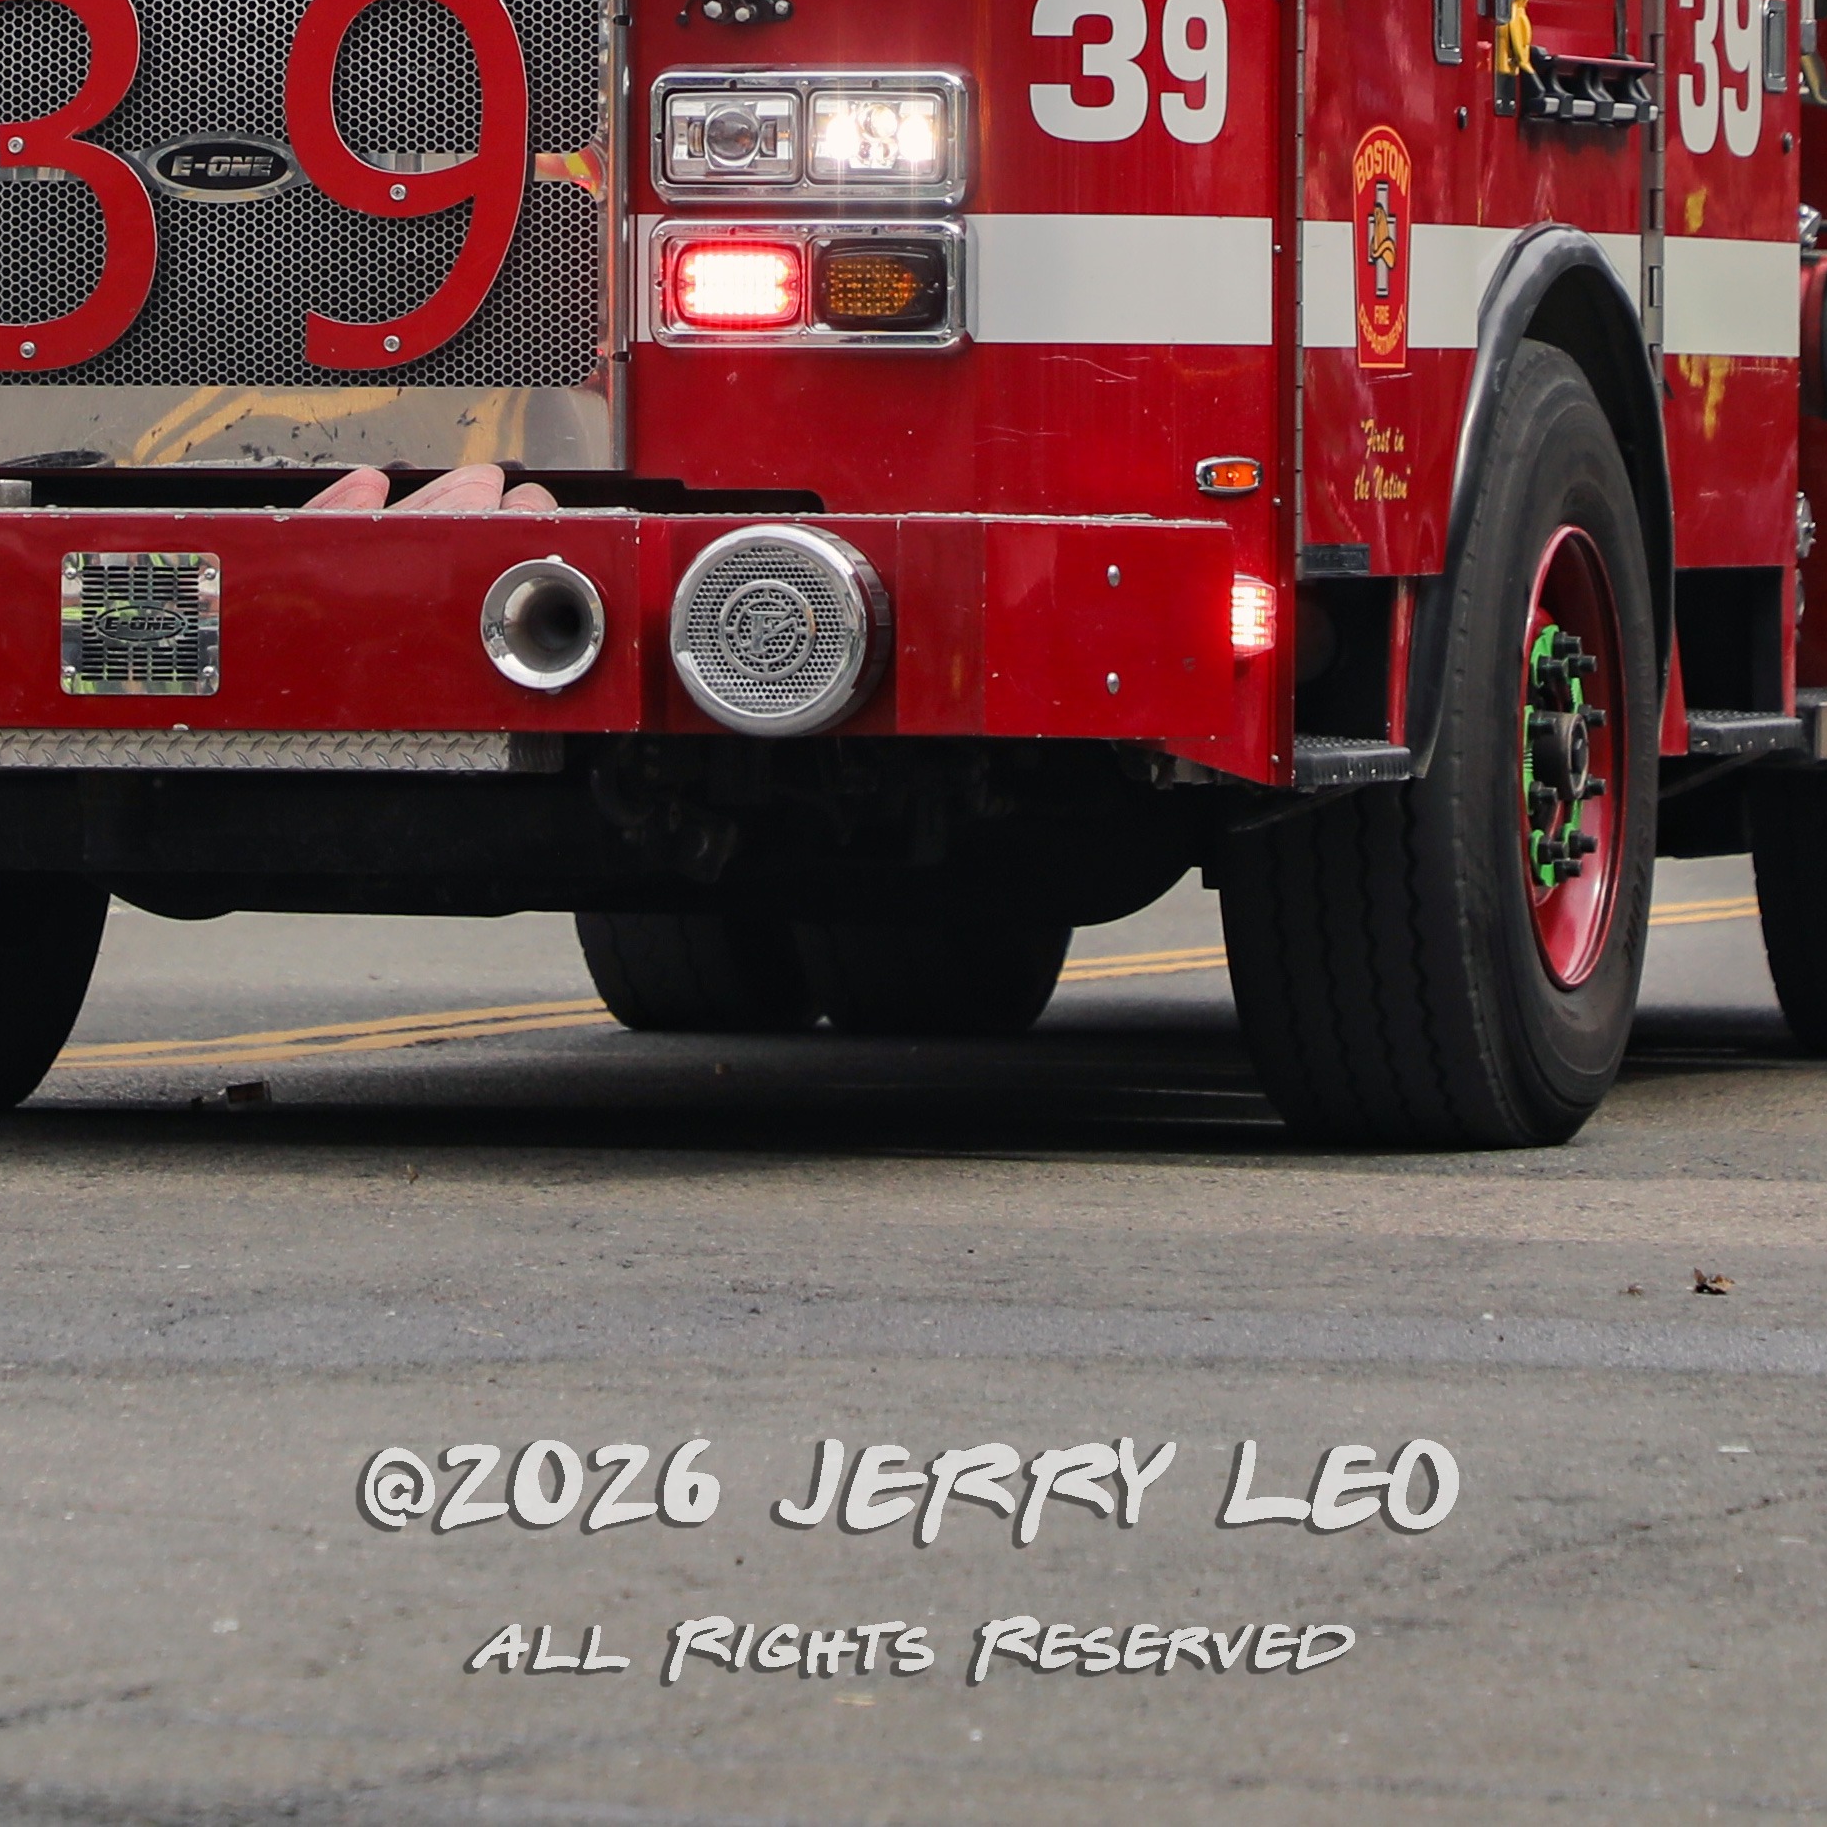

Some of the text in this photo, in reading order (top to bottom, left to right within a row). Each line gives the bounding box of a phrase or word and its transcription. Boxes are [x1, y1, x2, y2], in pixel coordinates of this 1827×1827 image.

[170, 155, 274, 177] E-ONE
[1355, 139, 1410, 197] BOSTON
[1374, 304, 1390, 325] FIRE
[1358, 302, 1406, 356] DEPARTMENT
[1394, 427, 1405, 453] in
[1354, 464, 1371, 501] the
[104, 615, 176, 632] E-ONE
